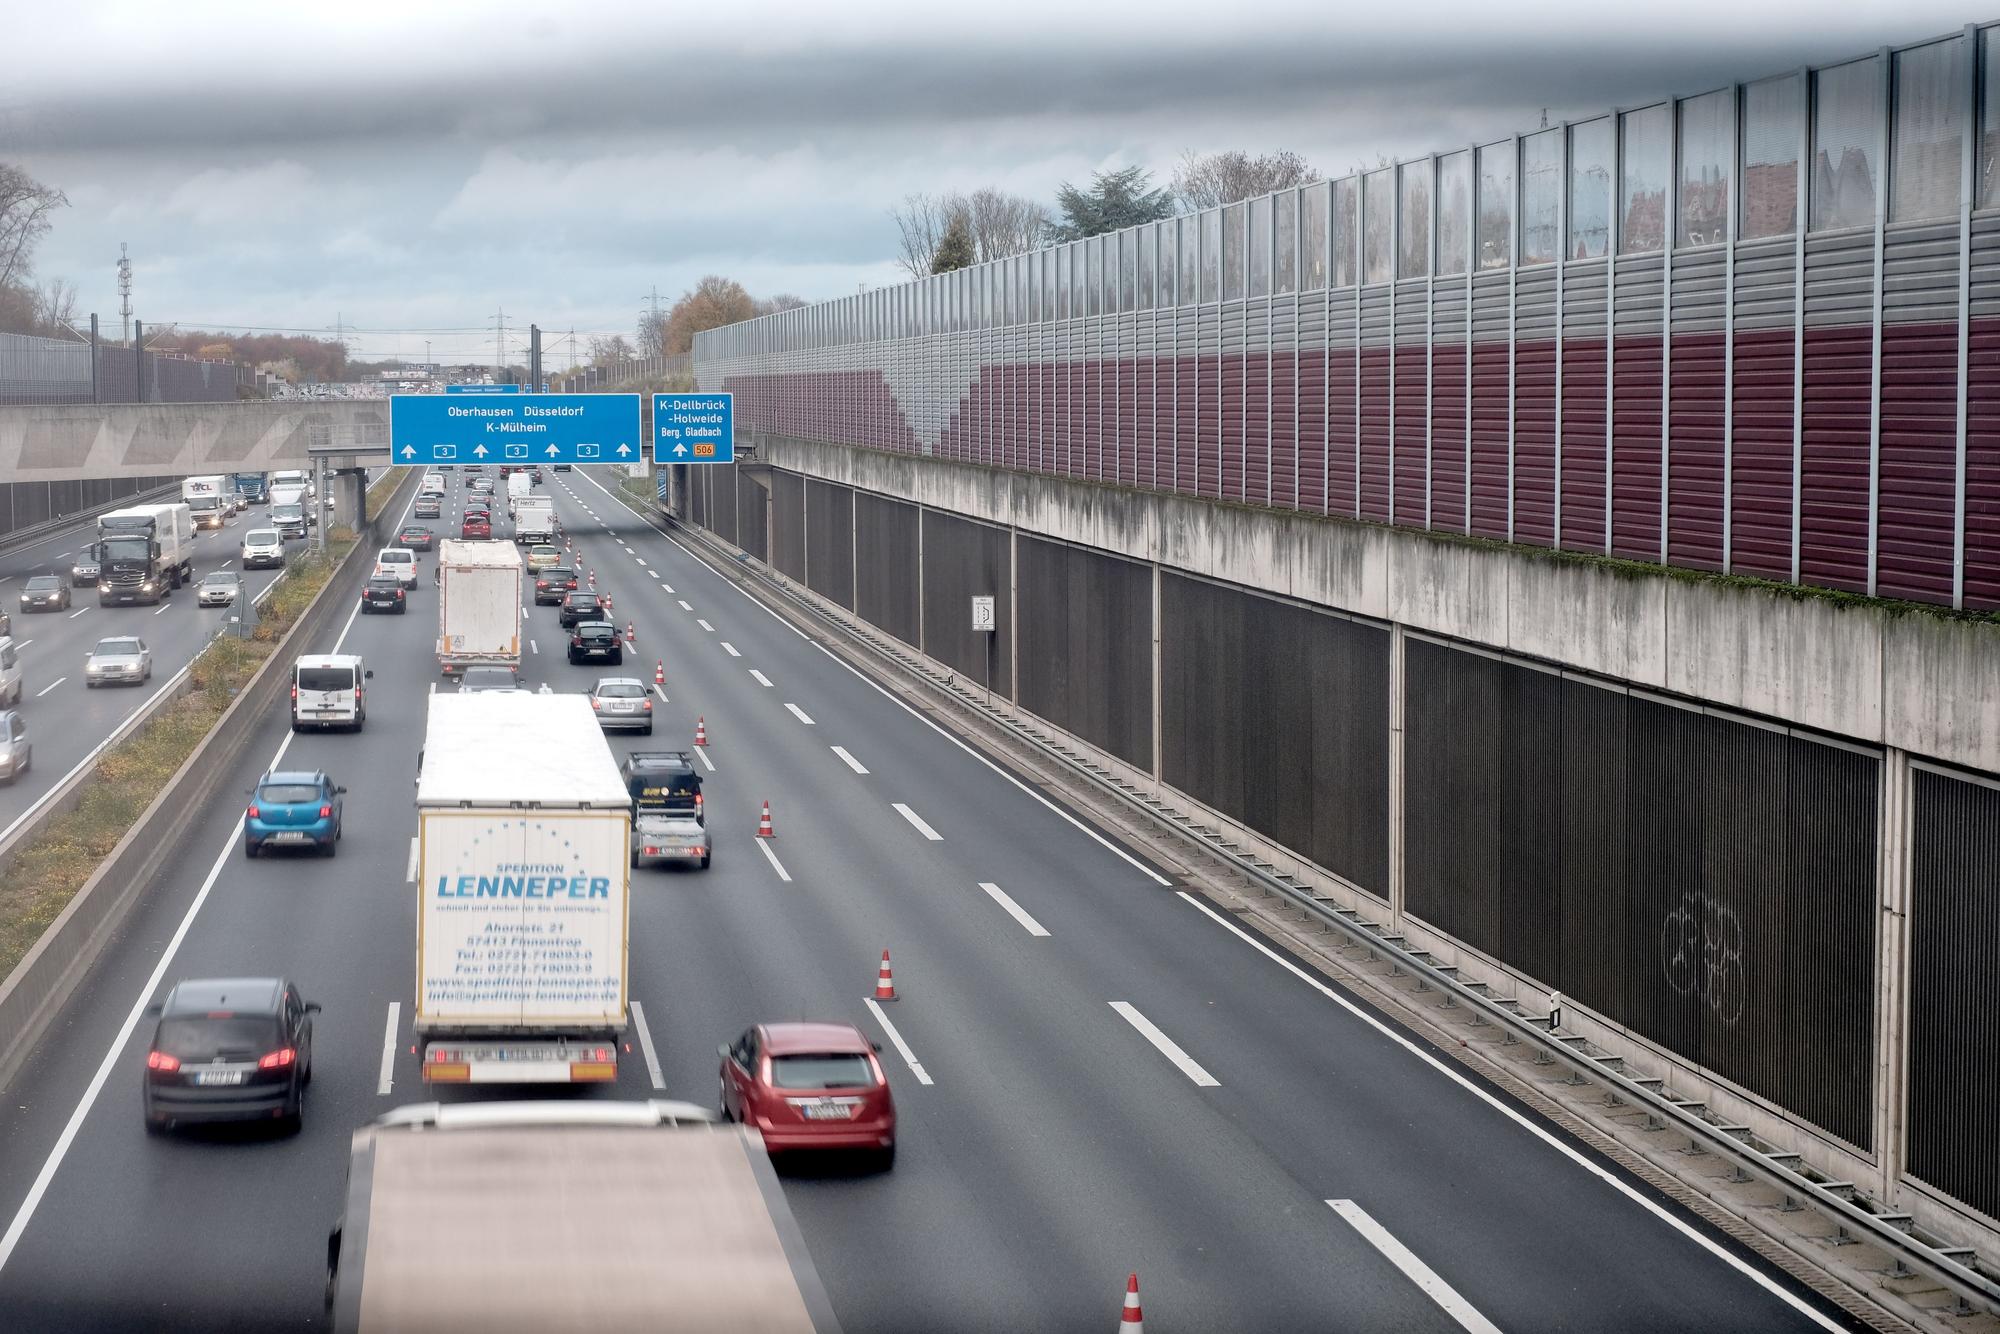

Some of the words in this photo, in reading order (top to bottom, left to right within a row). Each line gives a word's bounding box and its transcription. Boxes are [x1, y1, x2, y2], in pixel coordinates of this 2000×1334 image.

[660, 400, 726, 410] K-Dellbrück
[448, 407, 513, 416] Oberhausen
[524, 406, 584, 416] Düsseldorf
[668, 413, 723, 423] -Holweide
[486, 422, 547, 432] K-Mülheim
[661, 427, 682, 439] Berg.
[685, 427, 722, 437] Gladbach
[442, 447, 448, 456] 3
[514, 447, 520, 455] 3
[585, 446, 591, 455] 3
[696, 445, 712, 454] 506
[496, 863, 565, 873] SPEDITION
[437, 876, 610, 898] LENNEPER
